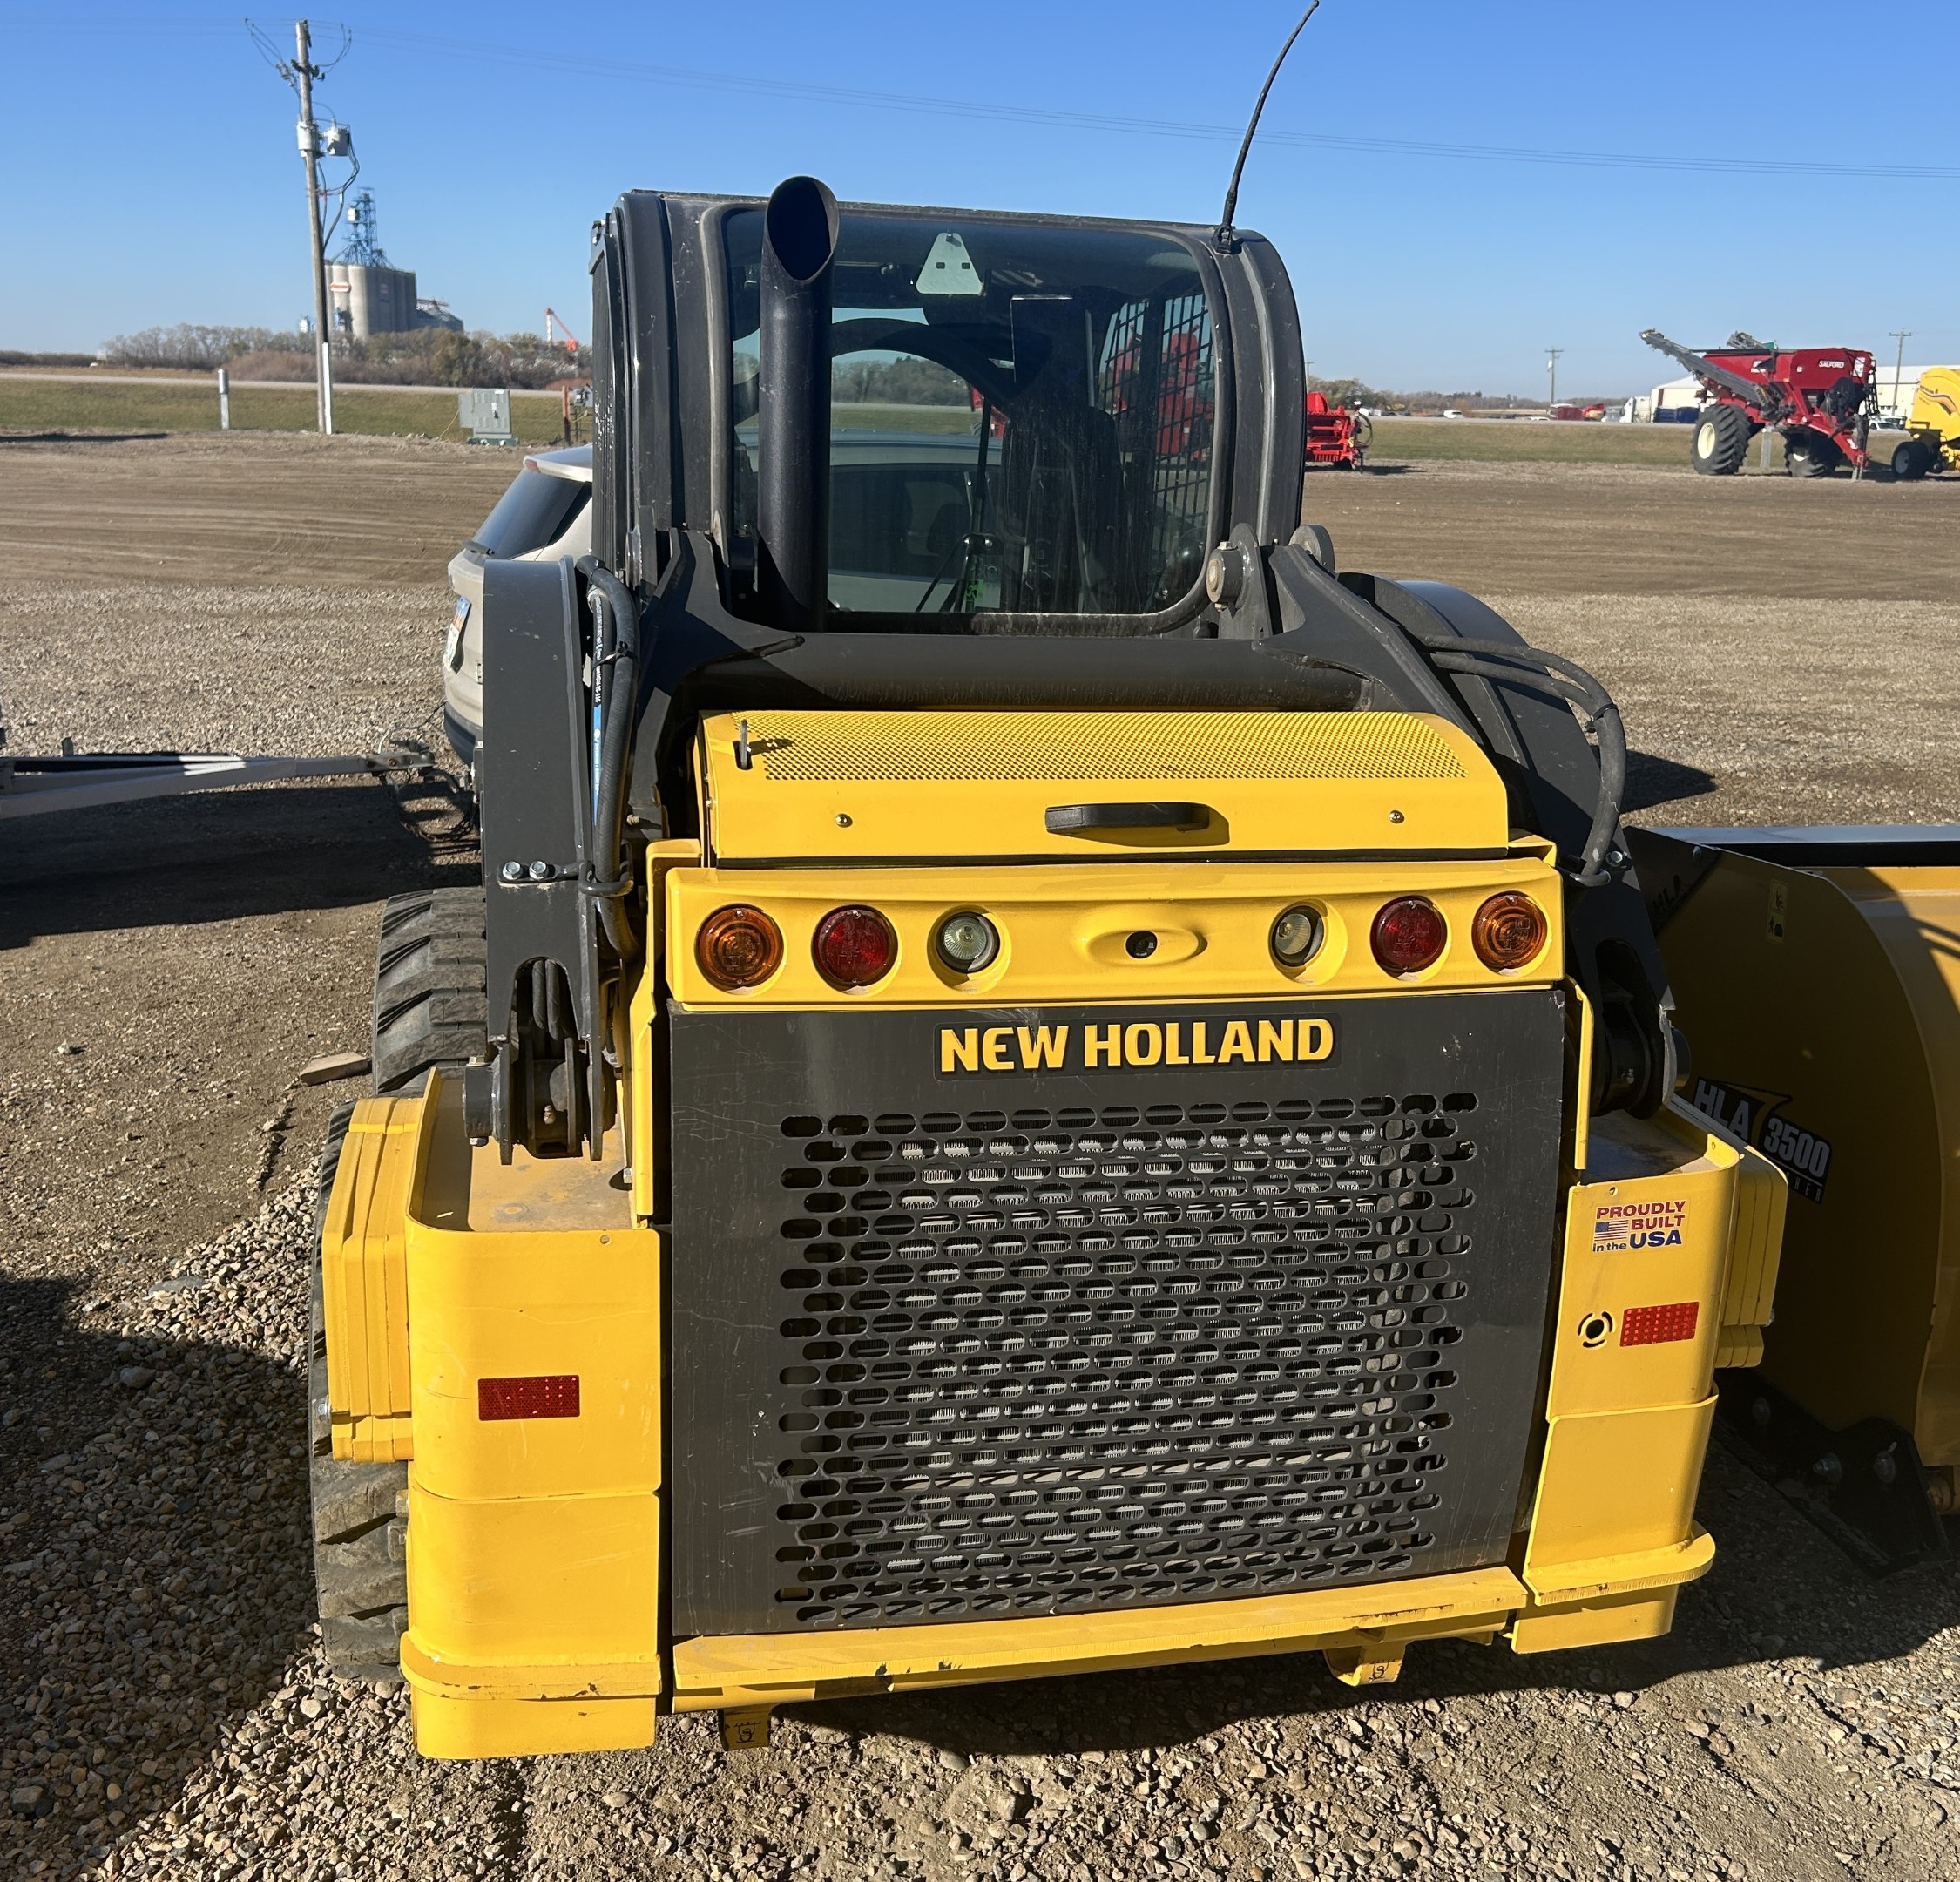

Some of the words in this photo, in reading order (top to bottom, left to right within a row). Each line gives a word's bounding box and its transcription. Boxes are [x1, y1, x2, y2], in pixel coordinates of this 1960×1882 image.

[941, 1025, 1069, 1073] NEW
[1084, 1018, 1335, 1067] HOLLAND
[1693, 1079, 1750, 1141] HLA
[1763, 1117, 1831, 1178] 3500
[1596, 1201, 1686, 1220] PROUDLY
[1631, 1215, 1686, 1230] BUILT
[1592, 1243, 1605, 1252] in
[1606, 1242, 1627, 1251] the
[1629, 1229, 1682, 1249] USA
